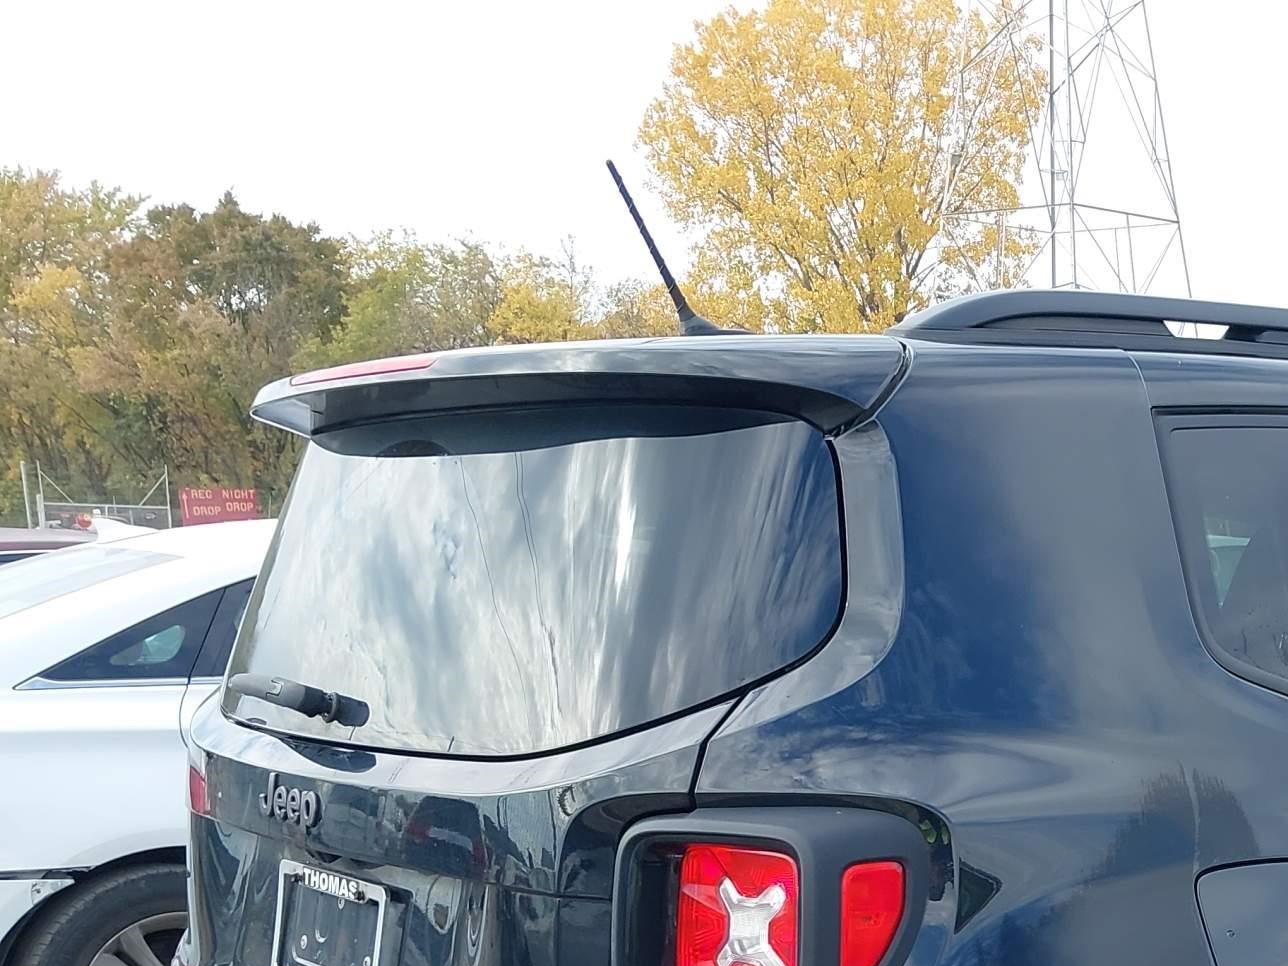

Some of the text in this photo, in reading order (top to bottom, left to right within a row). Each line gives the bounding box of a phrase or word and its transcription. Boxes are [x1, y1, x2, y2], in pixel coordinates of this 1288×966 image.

[226, 501, 254, 512] DROP
[257, 772, 320, 829] Jeep
[304, 867, 359, 900] THOMAS
